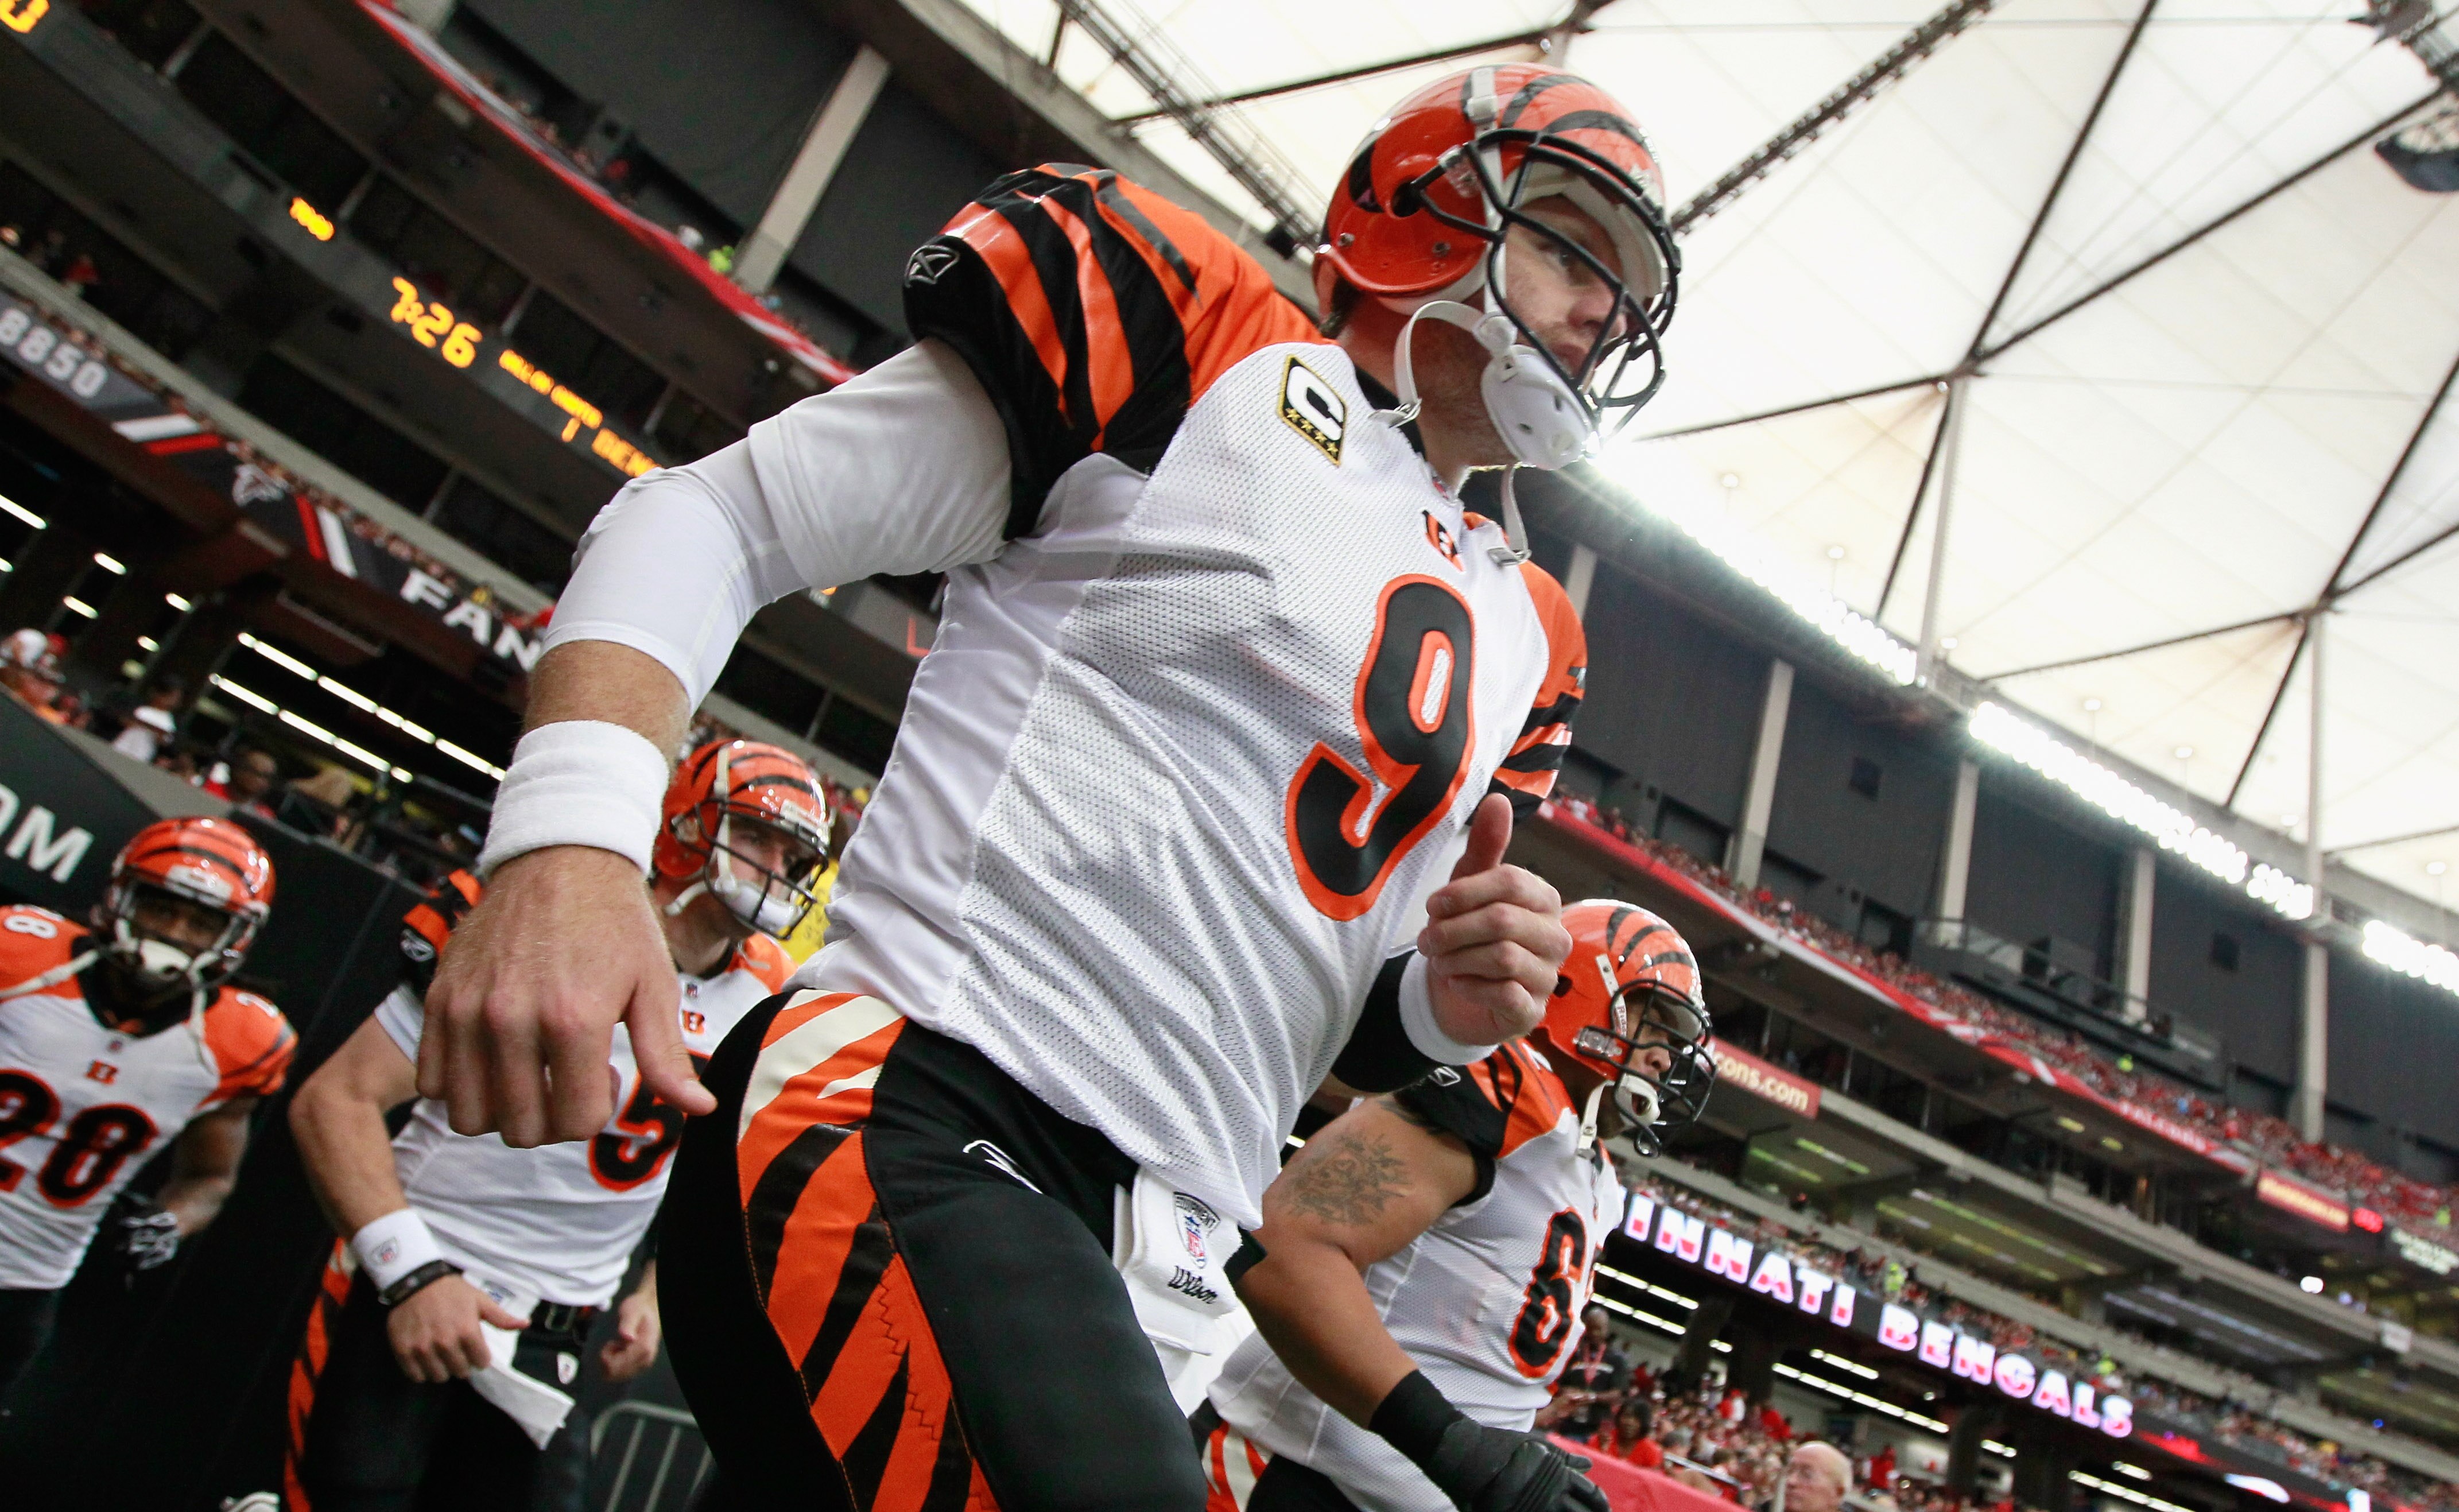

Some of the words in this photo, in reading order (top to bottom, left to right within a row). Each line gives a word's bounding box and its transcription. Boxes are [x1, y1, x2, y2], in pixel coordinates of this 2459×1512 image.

[0, 308, 109, 397] 8850
[390, 276, 483, 369] 7:26
[1286, 365, 1344, 441] C
[400, 568, 541, 673] FAN
[1285, 573, 1476, 922] 9
[1168, 1265, 1218, 1305] Wilson
[1508, 1207, 1599, 1378] 6
[1622, 1187, 1857, 1328] INNATI
[1876, 1302, 2134, 1439] BENGALS
